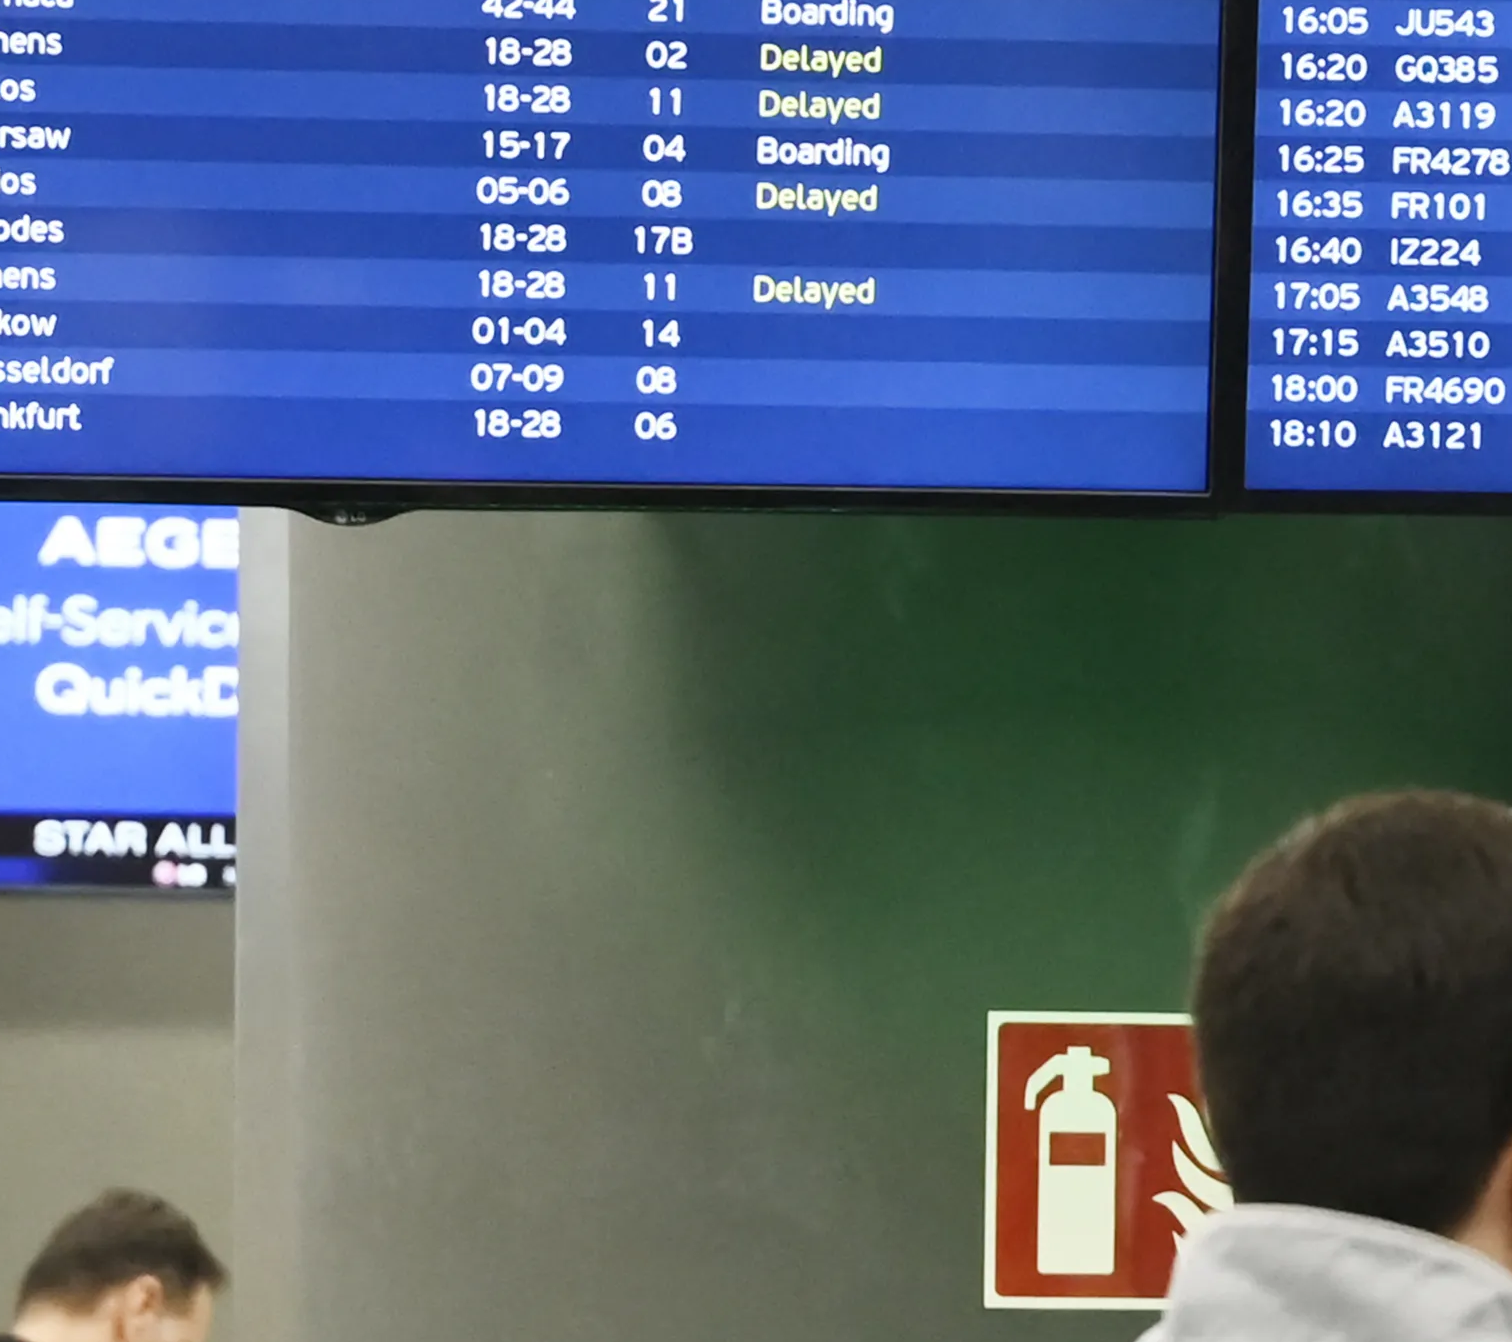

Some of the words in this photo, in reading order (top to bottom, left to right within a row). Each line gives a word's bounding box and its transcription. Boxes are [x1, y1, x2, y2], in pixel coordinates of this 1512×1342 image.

[484, 83, 571, 114] 18-28
[649, 86, 682, 116] 11
[758, 89, 881, 125] Delayed
[482, 130, 571, 160] 15-17
[642, 134, 687, 163] 04
[756, 135, 890, 174] Boarding
[1278, 144, 1365, 174] 16:25
[1392, 146, 1511, 176] FR4278
[476, 176, 570, 206] 05-06
[641, 179, 683, 208] 08
[755, 181, 878, 217] Delayed
[1275, 235, 1363, 265] 16:40
[1390, 237, 1482, 267] IZ224
[1272, 327, 1359, 357] 17:15
[1385, 330, 1490, 359] A3510
[470, 362, 565, 393] 07-09
[635, 365, 677, 395] 08
[33, 818, 148, 858] STAR
